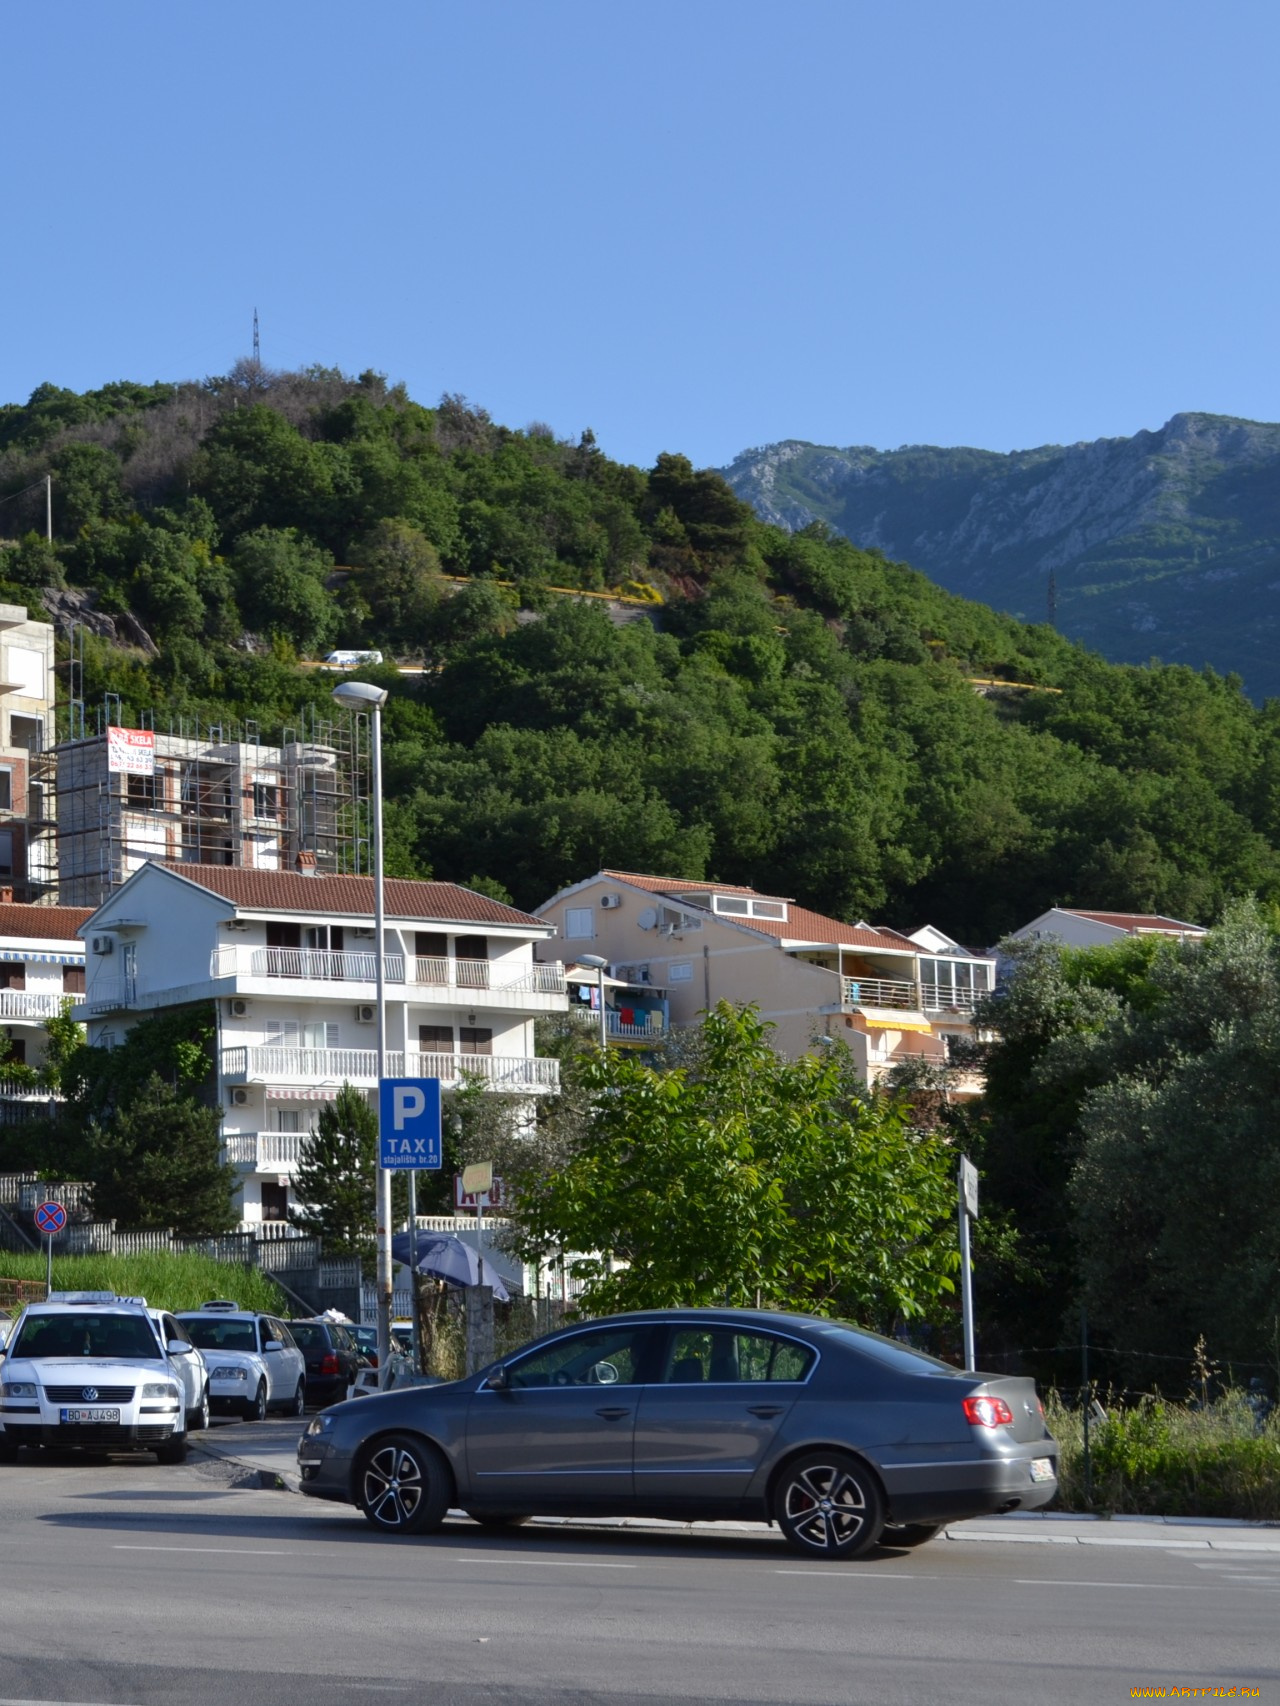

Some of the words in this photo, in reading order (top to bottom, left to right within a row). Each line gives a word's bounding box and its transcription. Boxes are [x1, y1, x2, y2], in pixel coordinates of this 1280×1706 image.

[393, 1086, 426, 1131] P
[387, 1139, 434, 1154] TAXI
[68, 1410, 81, 1421] BD
